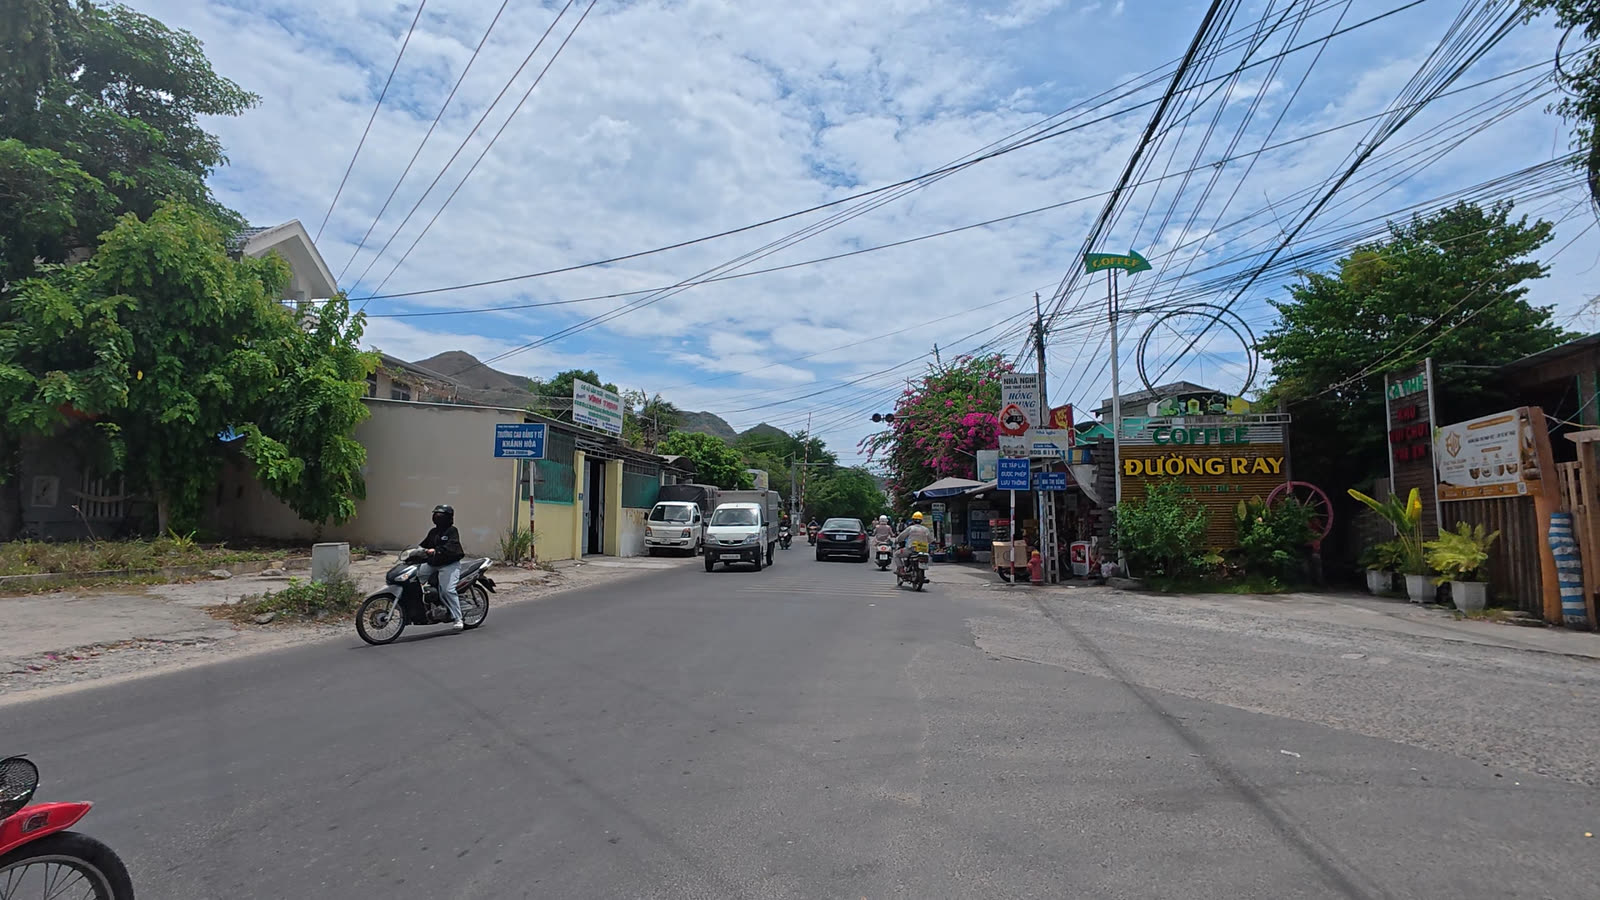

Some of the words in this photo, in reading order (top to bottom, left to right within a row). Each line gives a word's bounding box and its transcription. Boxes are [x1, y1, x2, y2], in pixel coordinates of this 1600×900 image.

[1092, 257, 1139, 267] COFFEE
[1003, 376, 1018, 385] NHÀ
[1020, 375, 1037, 385] NGHỈ
[1153, 427, 1250, 445] COFFEE
[502, 439, 523, 448] KHÁNH
[1123, 452, 1226, 476] ĐƯỜNG
[1230, 456, 1285, 475] RAY
